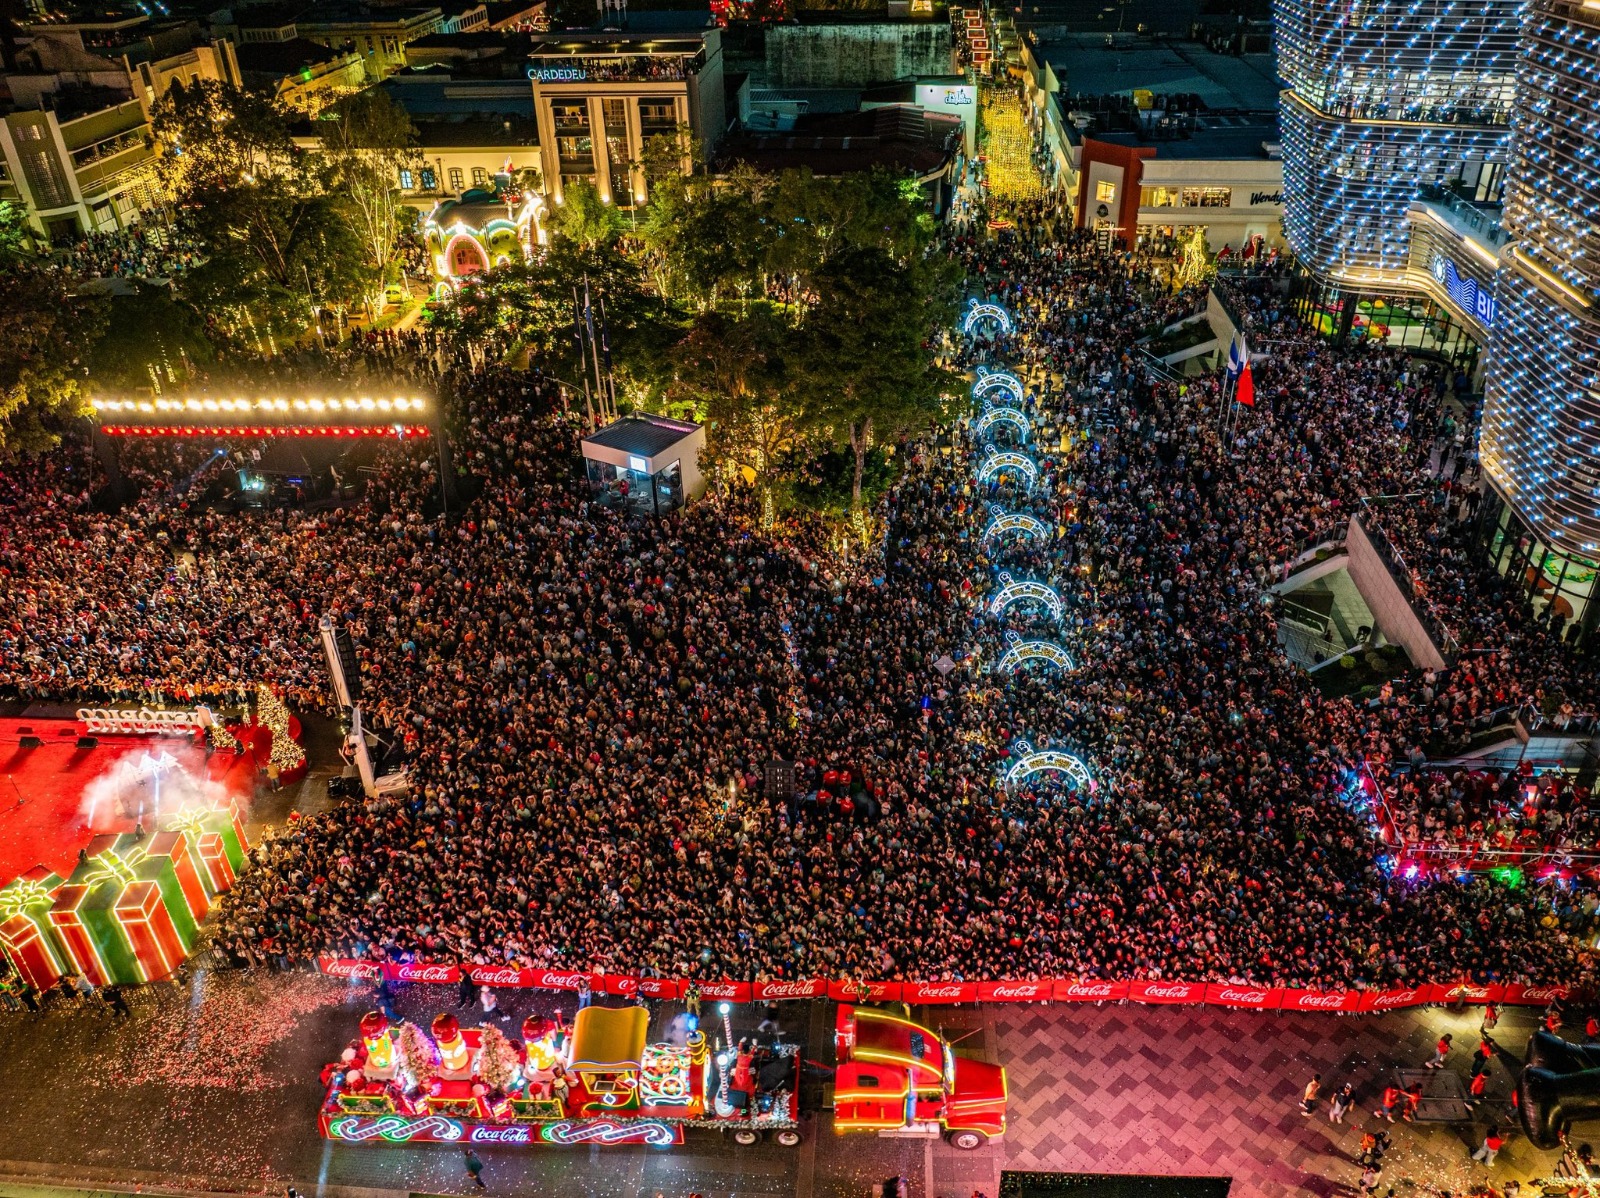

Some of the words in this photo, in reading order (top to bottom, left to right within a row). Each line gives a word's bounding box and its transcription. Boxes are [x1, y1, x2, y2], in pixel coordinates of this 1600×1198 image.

[527, 68, 587, 80] CARDEDEU
[399, 965, 455, 980] Coca-Cola
[470, 968, 522, 983] Coca-Cola
[762, 979, 817, 997] Coca-Cola
[918, 985, 963, 997] Coca-Cola
[993, 985, 1039, 997] Coca-Cola
[1067, 984, 1112, 996] Coca-Cola
[1144, 985, 1191, 998] Coca-Cola
[1220, 989, 1266, 1003] Coca-Cola
[1298, 994, 1346, 1008] Coca-Cola
[1373, 990, 1416, 1006] Coca-Cola
[471, 1127, 531, 1142] Coca-Cola
